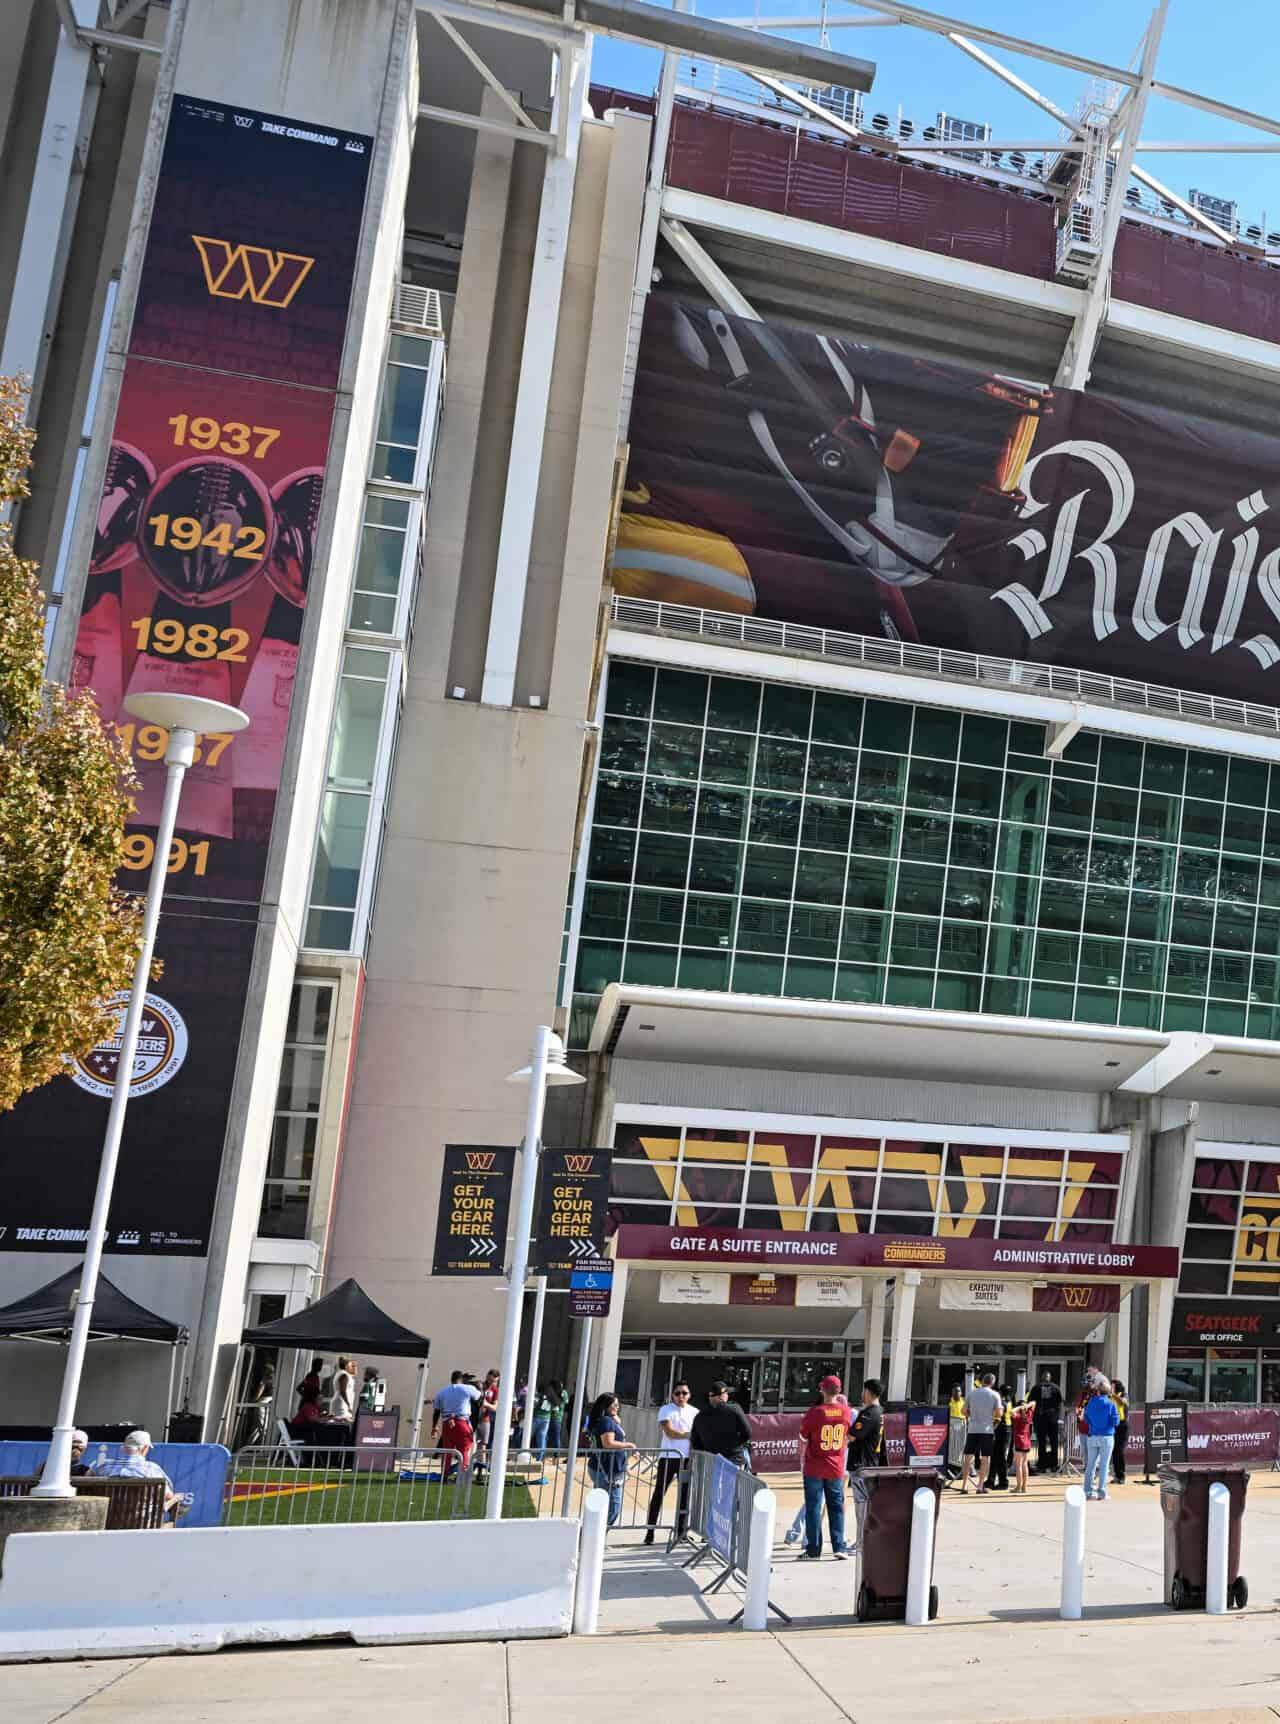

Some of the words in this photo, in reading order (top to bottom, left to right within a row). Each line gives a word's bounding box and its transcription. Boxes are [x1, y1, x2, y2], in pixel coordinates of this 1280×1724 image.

[261, 121, 286, 136] TAKE
[286, 127, 339, 146] COMMAND
[192, 235, 315, 308] W
[169, 414, 281, 458] 1937
[148, 514, 266, 561] 1942
[131, 617, 250, 663] 1982
[121, 834, 211, 876] 991
[465, 1152, 496, 1170] W
[564, 1155, 594, 1172] W
[454, 1185, 485, 1197] GET
[553, 1187, 584, 1198] GET
[454, 1198, 495, 1210] YOUR
[553, 1200, 593, 1212] YOUR
[451, 1211, 494, 1223] GEAR
[551, 1212, 592, 1224] GEAR
[16, 1228, 47, 1240] TAKE
[47, 1228, 110, 1242] COMMAD
[450, 1224, 494, 1236] HERE.
[550, 1225, 593, 1237] HERE.
[671, 1236, 706, 1251] GATE
[708, 1239, 720, 1251] A
[722, 1239, 761, 1253] SUITE
[765, 1241, 838, 1256] ENTRANCE
[884, 1247, 945, 1261] COMMANDERS
[993, 1250, 1095, 1265] ADMINISTRATIVE
[1097, 1254, 1135, 1267] LOBBY
[969, 1283, 1004, 1293] EXECUTIVE
[975, 1292, 998, 1301] SUITES
[1062, 1287, 1092, 1307] W
[1184, 1313, 1263, 1332] SEATGEEK
[1200, 1333, 1216, 1342] BOX
[1217, 1334, 1244, 1342] OFFICE
[820, 1423, 845, 1451] 99
[1211, 1432, 1271, 1441] NORTHWEST
[751, 1440, 799, 1449] ORTHWE
[1224, 1440, 1261, 1448] STADIUM
[753, 1448, 798, 1456] STADIUM
